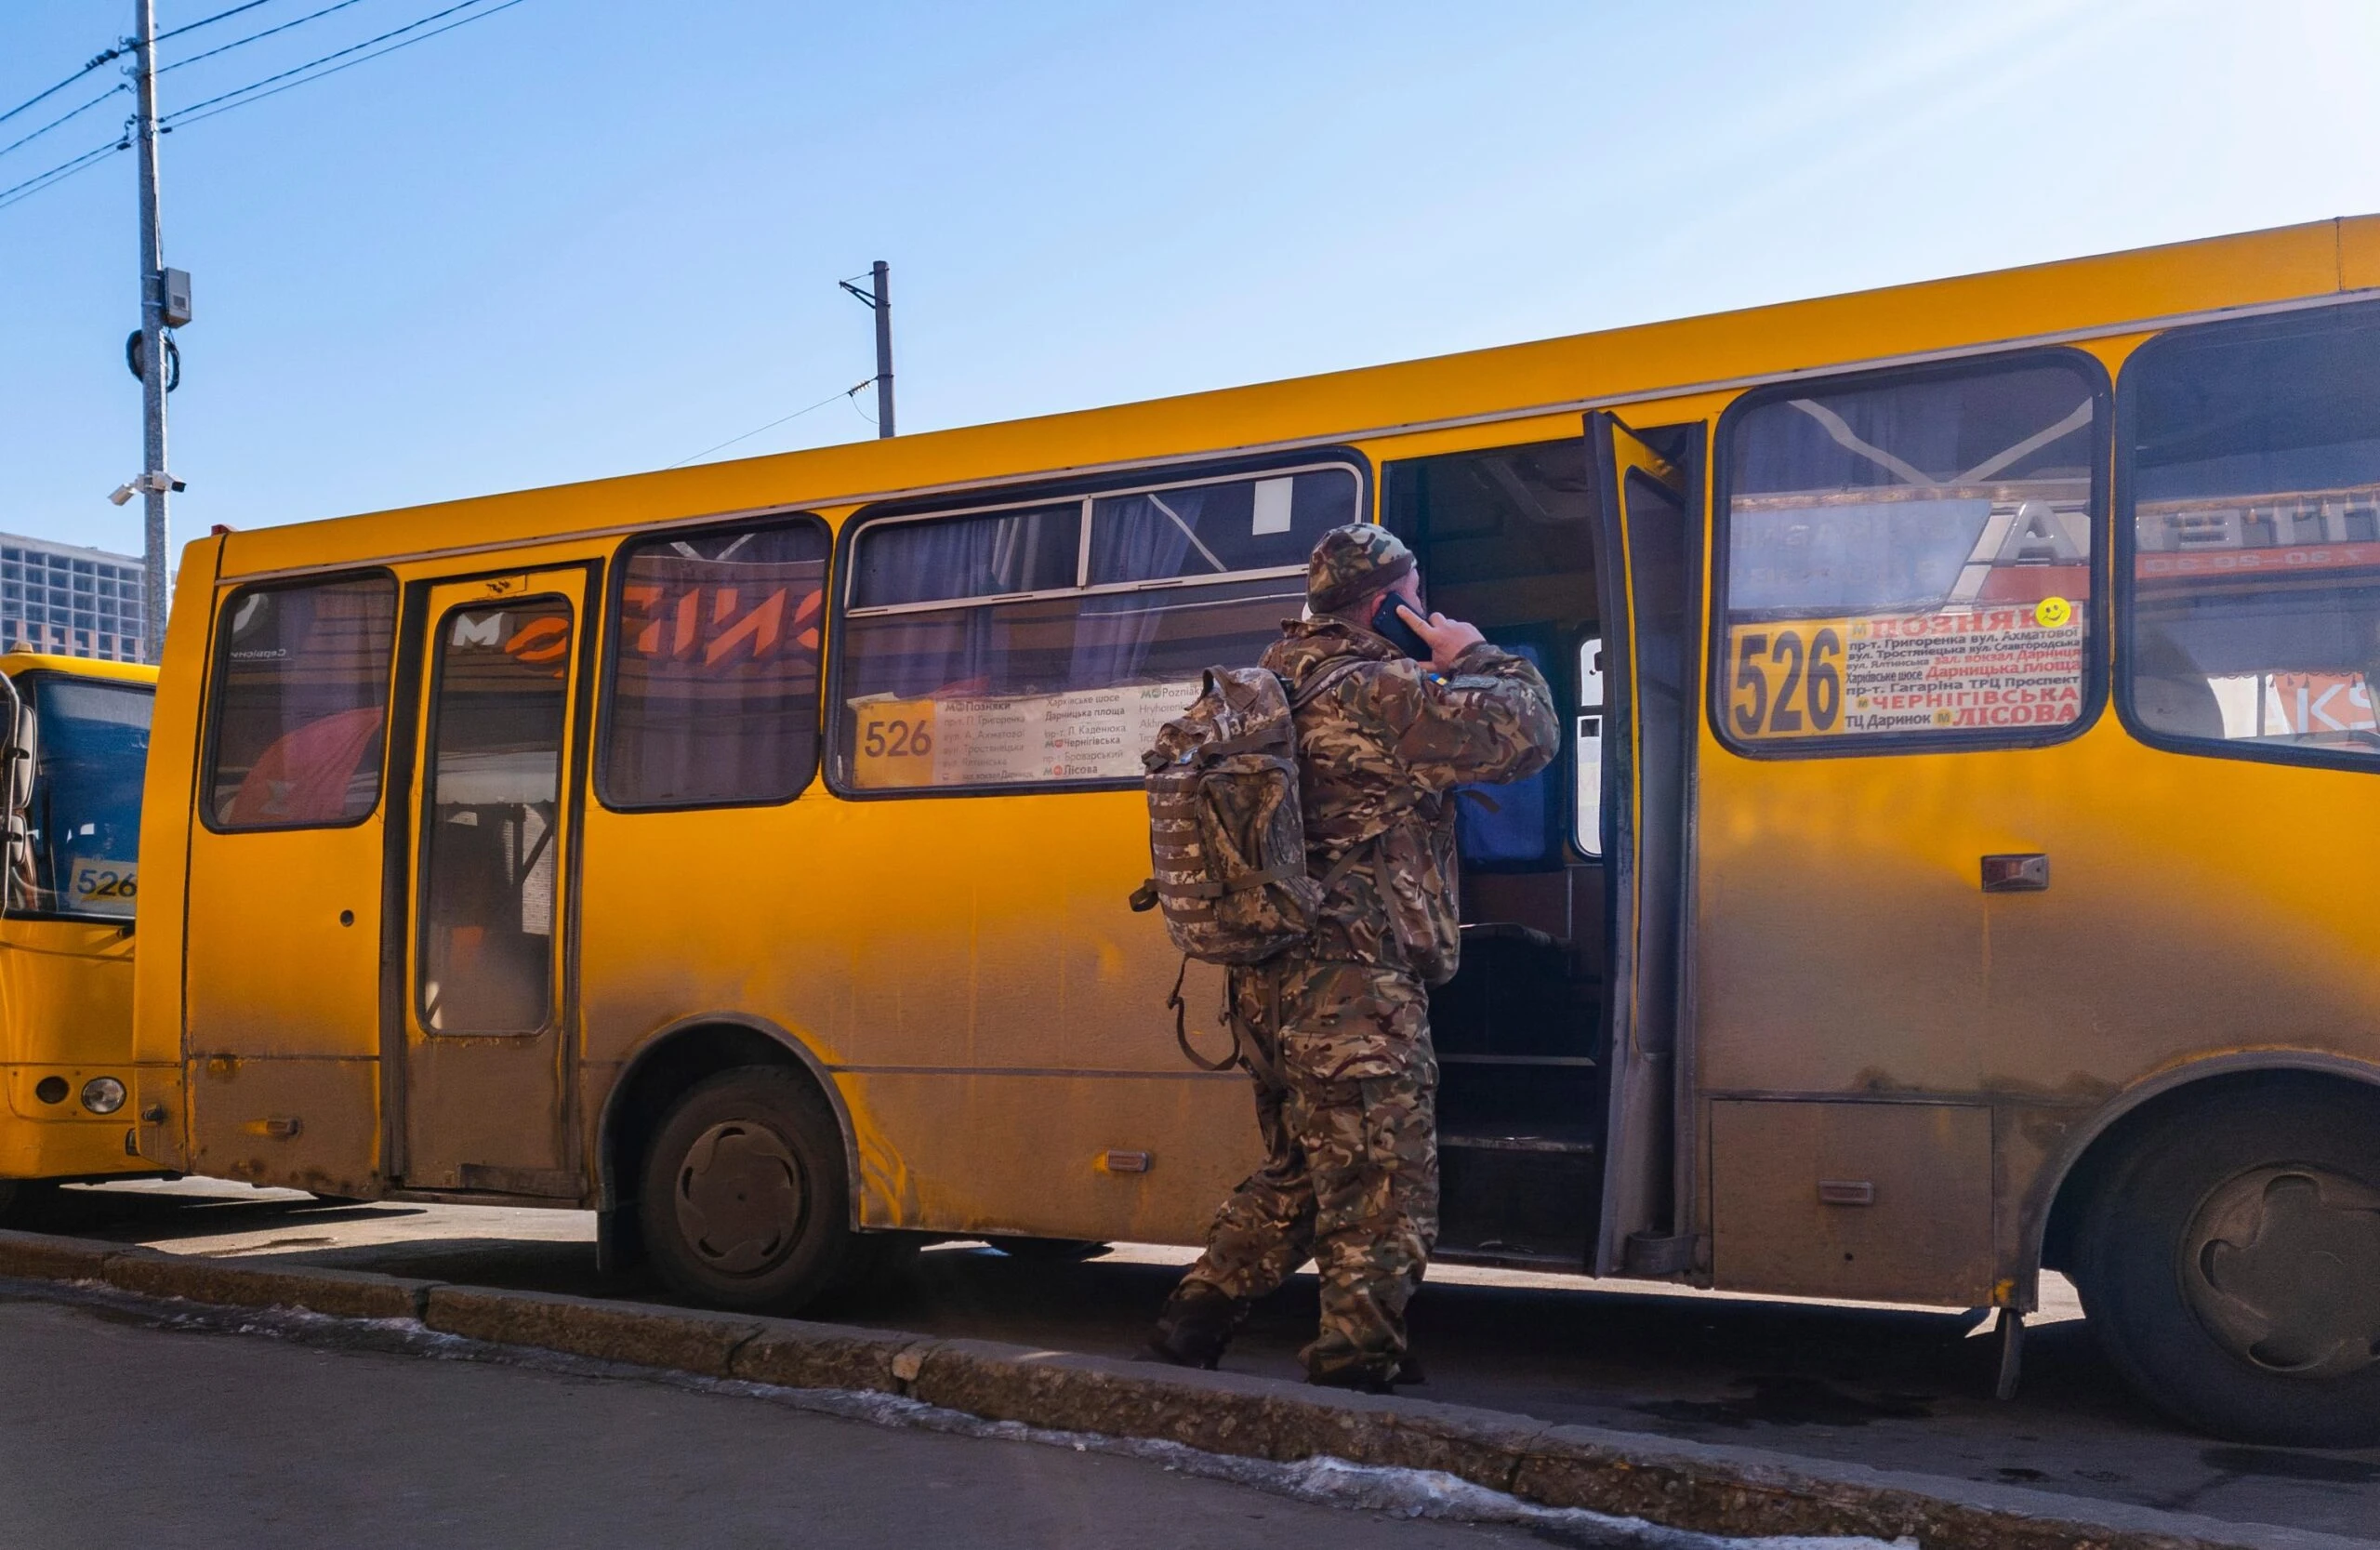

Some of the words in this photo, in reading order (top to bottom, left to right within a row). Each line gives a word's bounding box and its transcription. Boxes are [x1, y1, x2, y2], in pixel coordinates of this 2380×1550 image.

[1848, 652, 1873, 661] вул.
[1877, 646, 1966, 659] Тростянецька
[1994, 640, 2081, 651] Славгородська
[1849, 642, 1881, 653] пр-т.
[1885, 636, 1966, 650] Григоренка
[1971, 634, 1998, 645] вул.
[2002, 629, 2078, 642] Ахматової
[1871, 659, 1929, 669] Ялтинська
[2016, 648, 2081, 661] Дарниця
[1736, 628, 1840, 735] 526
[1845, 670, 1897, 684] Харківське
[1897, 670, 1923, 681] шосе
[1924, 663, 2019, 682] Дарницька
[2023, 660, 2081, 673] площа
[1845, 686, 1885, 697] пр-т.
[1890, 681, 1964, 693] Гагаріна
[1969, 678, 2001, 689] ТРЦ
[2005, 676, 2080, 688] Проспект
[1871, 685, 2079, 709] ЧЕРНІГІВСЬКА
[1095, 695, 1119, 703] шосе
[1094, 708, 1125, 717] площа
[1845, 715, 1864, 729] ТЦ
[1867, 713, 1931, 729] Даринок
[1952, 703, 2077, 725] ЛІСОВА
[865, 720, 932, 758] 526
[1064, 764, 1098, 776] Лісова
[77, 869, 137, 898] 526
